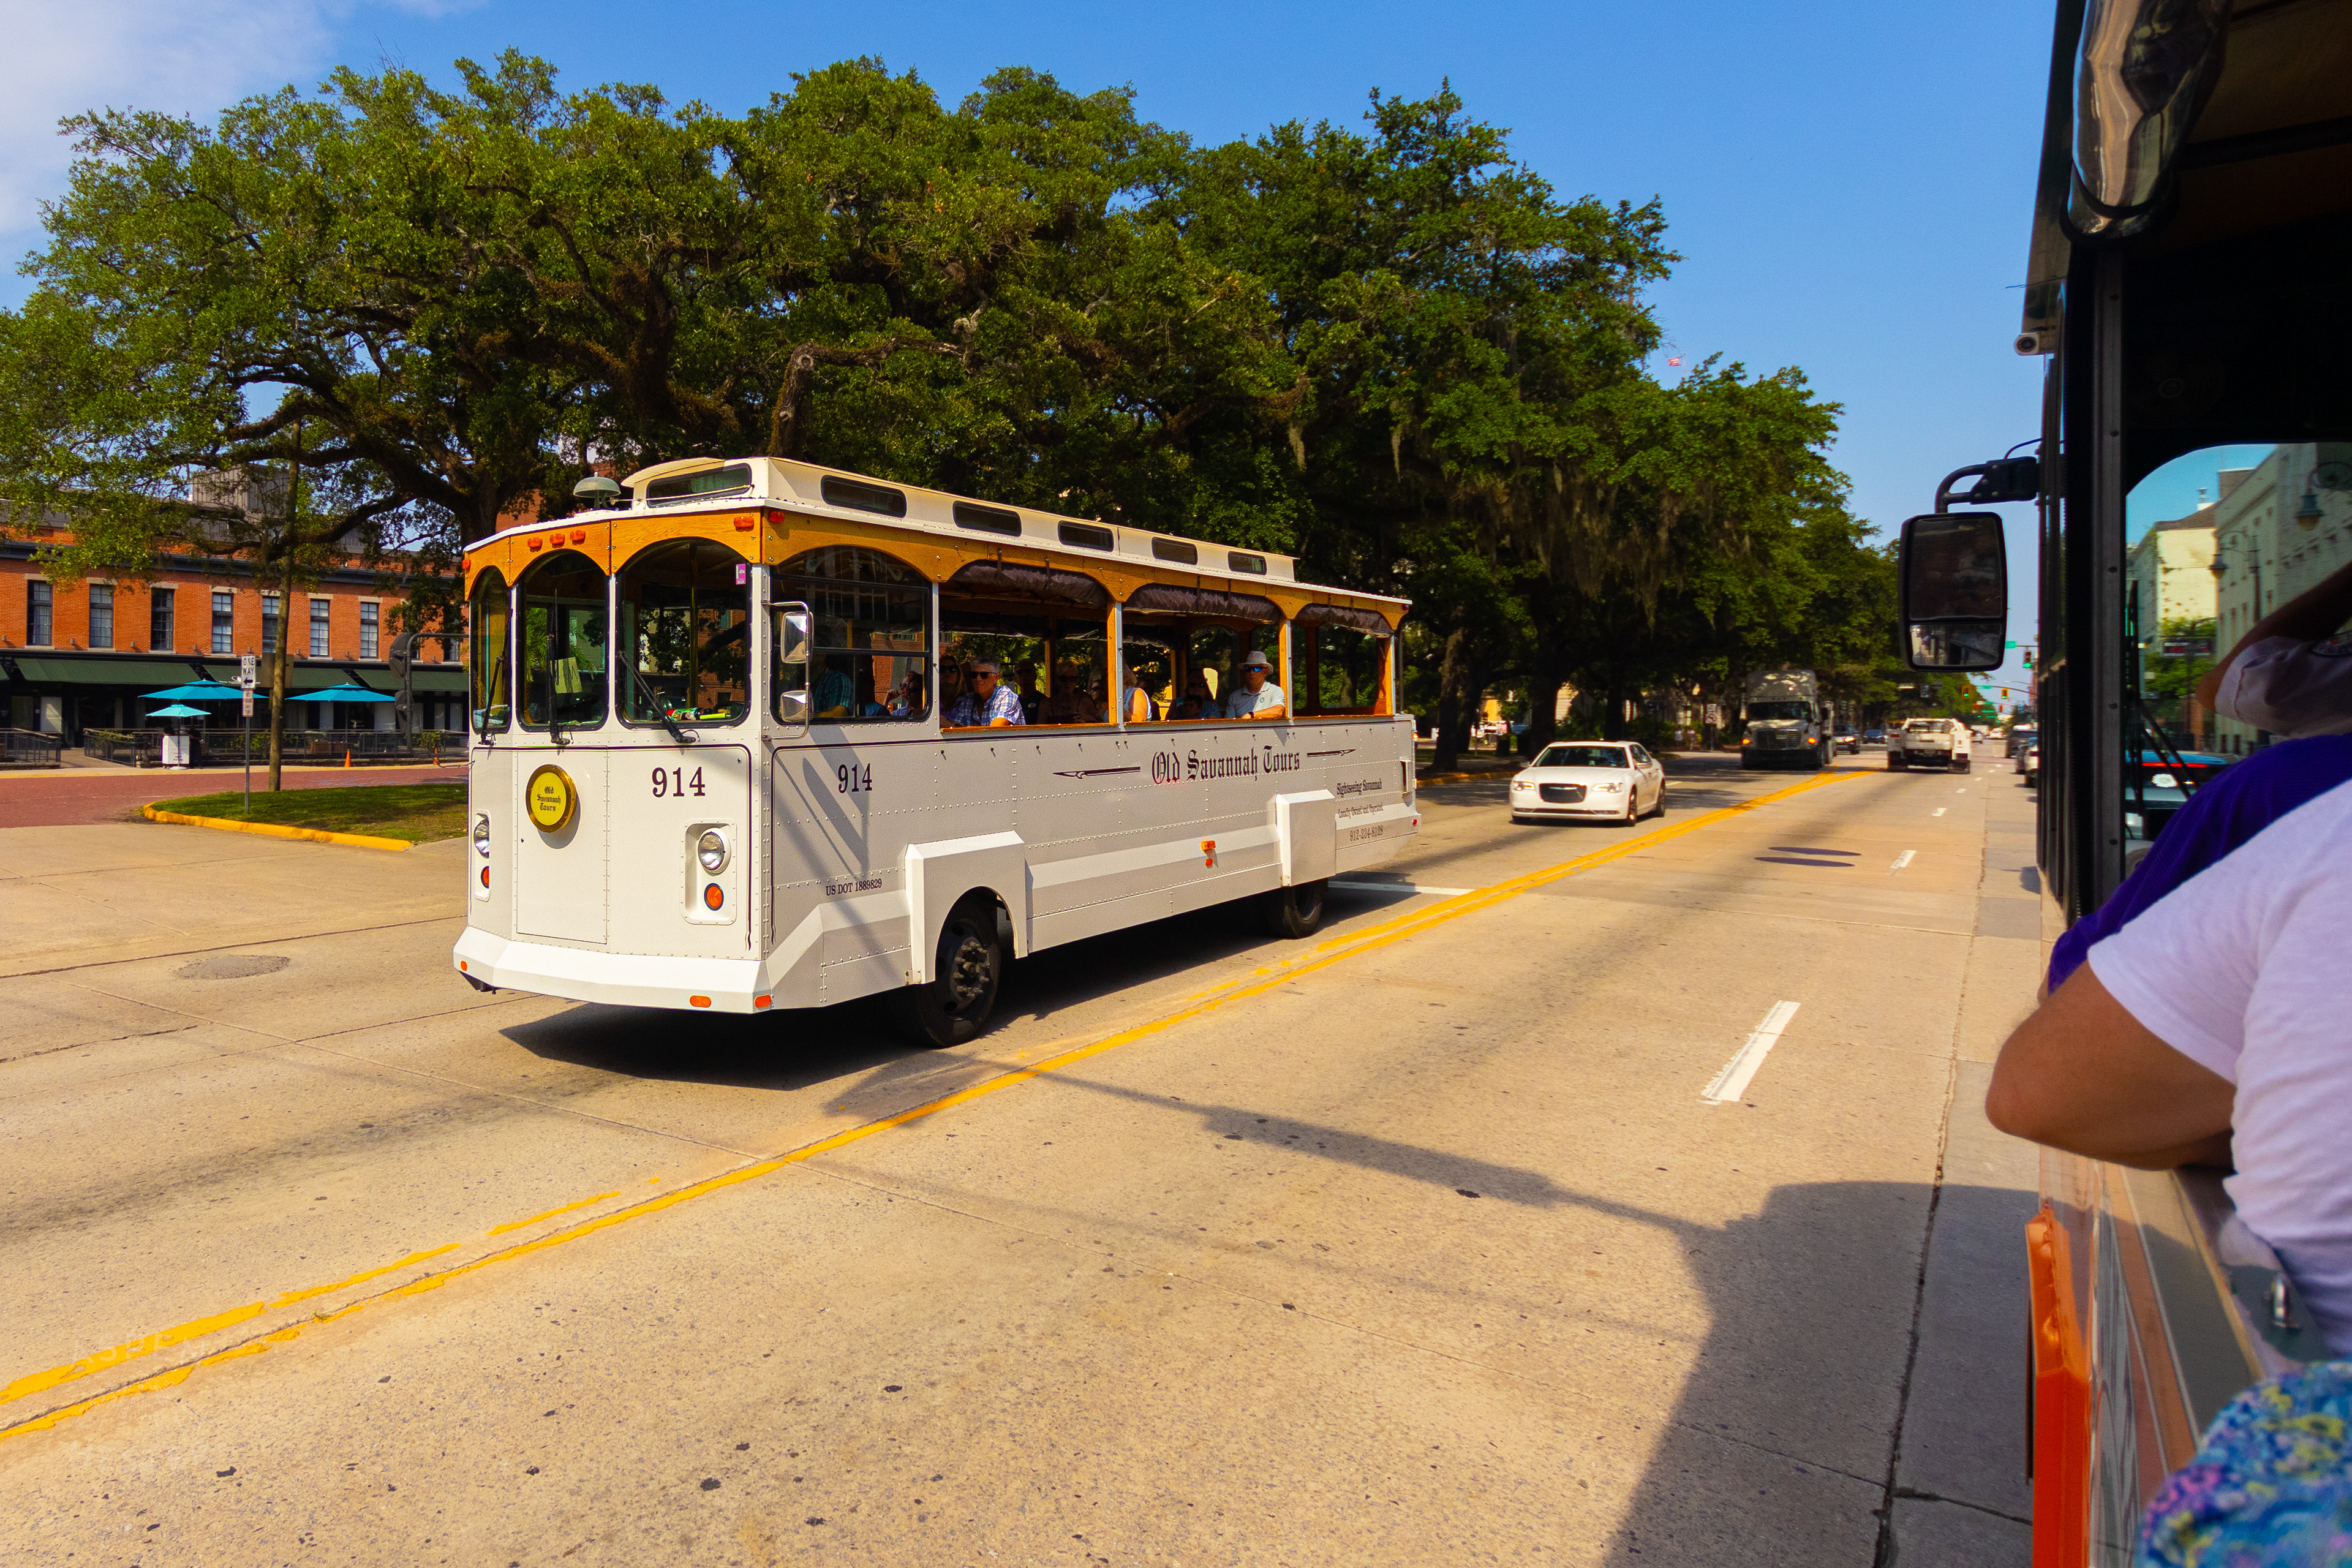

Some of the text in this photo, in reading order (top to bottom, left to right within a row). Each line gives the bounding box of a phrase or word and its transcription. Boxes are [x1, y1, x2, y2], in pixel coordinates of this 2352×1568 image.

[243, 657, 254, 666] ONE
[1152, 745, 1300, 784] Old Savannah Tours
[652, 766, 706, 797] 914
[838, 763, 872, 793] 914
[1336, 778, 1382, 797] Sightseeing Savannah
[537, 794, 561, 804] Savannah
[540, 803, 556, 812] Tours
[1349, 825, 1384, 842] 912-234-8128
[826, 878, 882, 896] US DOT 1889829
